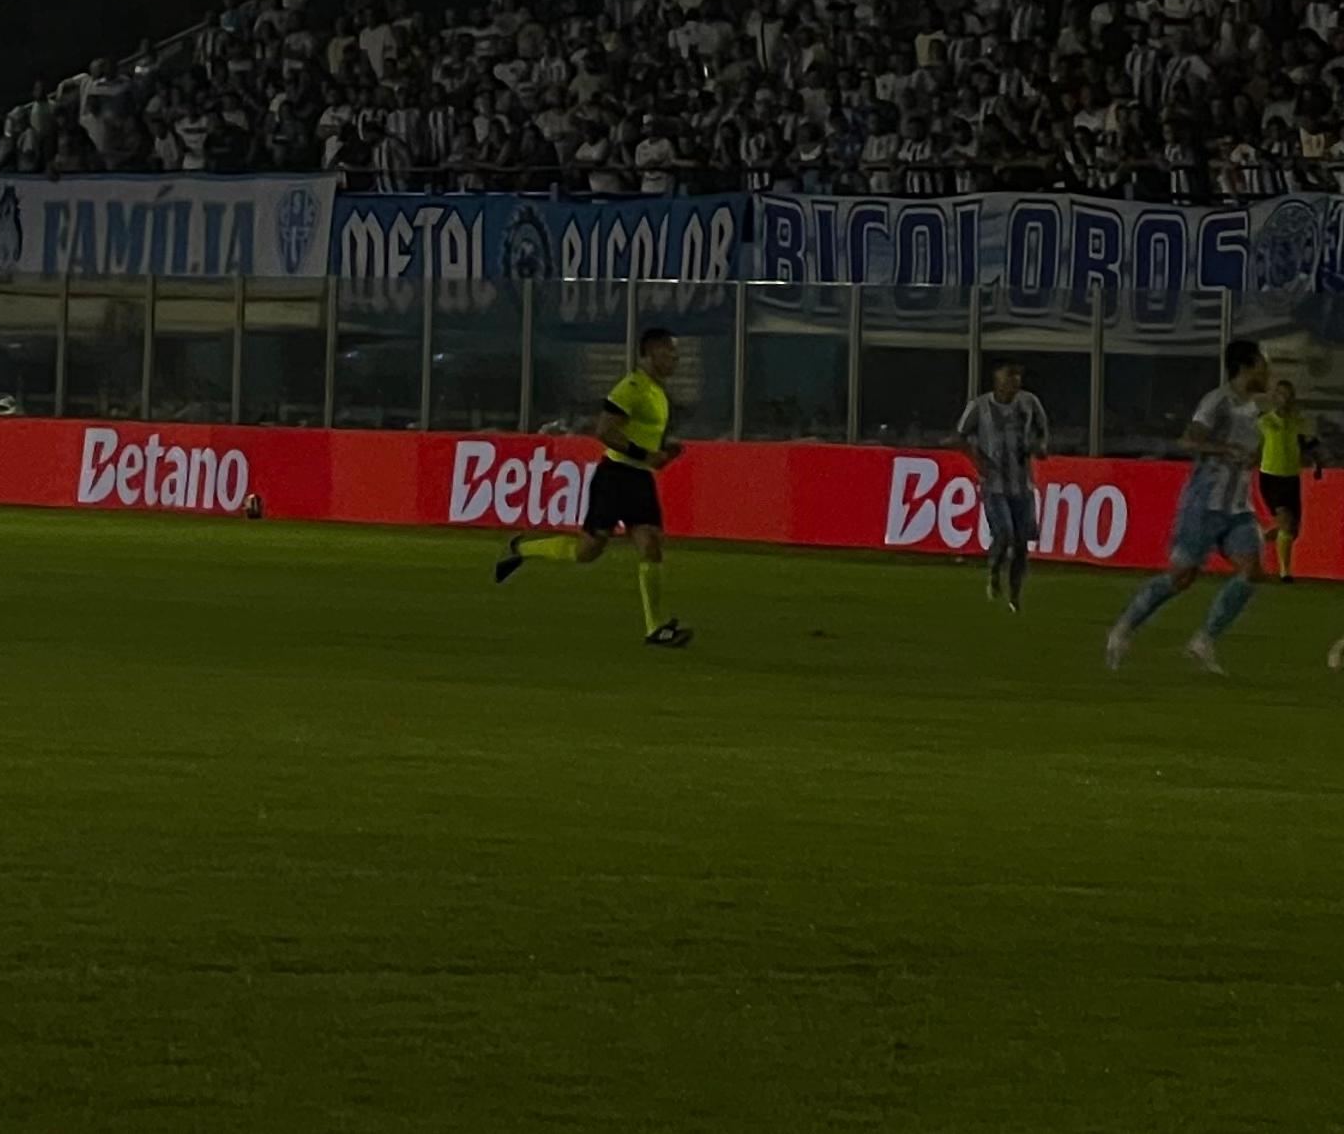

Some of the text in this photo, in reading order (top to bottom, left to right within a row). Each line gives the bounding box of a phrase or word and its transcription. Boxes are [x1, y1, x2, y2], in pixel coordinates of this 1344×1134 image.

[43, 184, 254, 275] FAMÍLIA
[77, 427, 249, 512] Betano
[885, 456, 1128, 558] Beno
